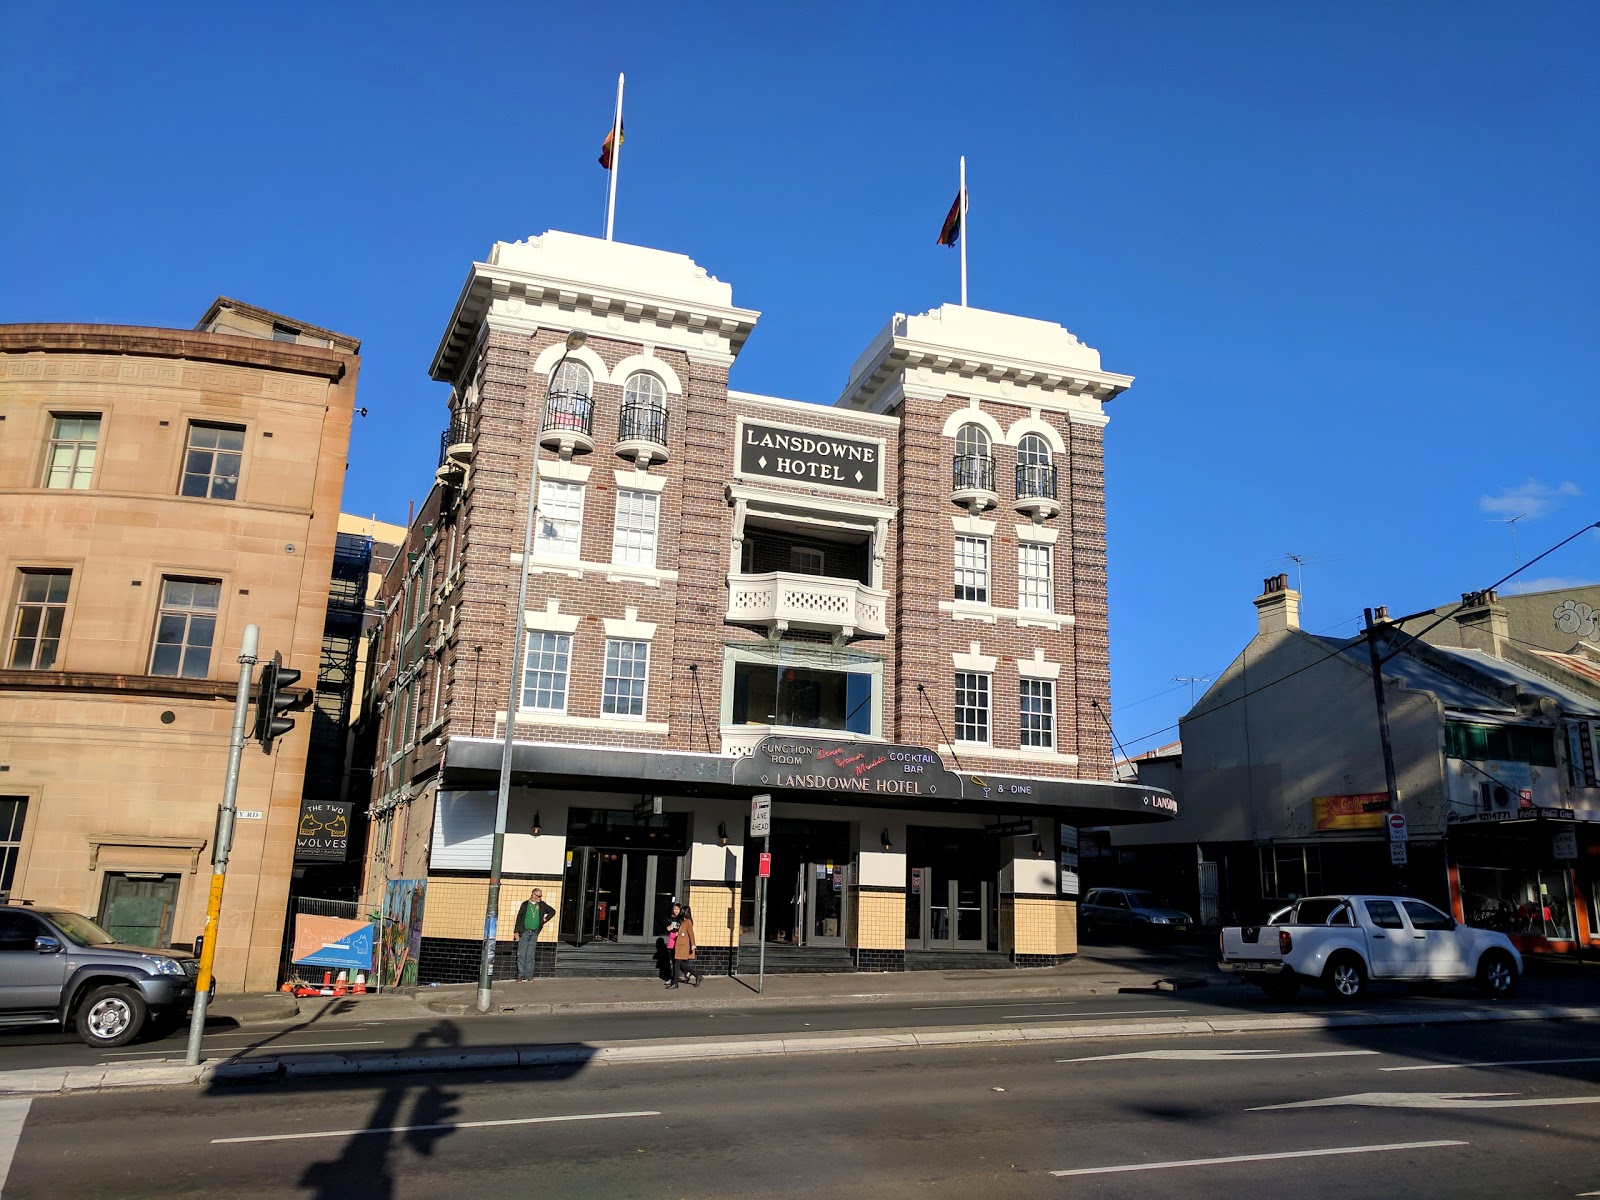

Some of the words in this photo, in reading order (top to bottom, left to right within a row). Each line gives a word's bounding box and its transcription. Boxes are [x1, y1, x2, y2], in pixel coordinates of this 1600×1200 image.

[747, 429, 875, 463] LANSDOWNE
[776, 457, 845, 481] HOTEL
[761, 743, 813, 755] FUNCTION
[771, 755, 802, 765] ROOM
[889, 752, 936, 764] COCKTAIL
[903, 764, 923, 774] BAR
[777, 773, 870, 791] LANSDOWNE
[876, 779, 922, 795] HOTEL
[997, 784, 1004, 793] &
[1010, 785, 1032, 795] DINE
[307, 805, 323, 813] THE
[326, 805, 344, 814] TWO
[753, 812, 767, 820] LANE
[752, 823, 769, 831] AHEAD
[297, 838, 347, 848] WOLVES
